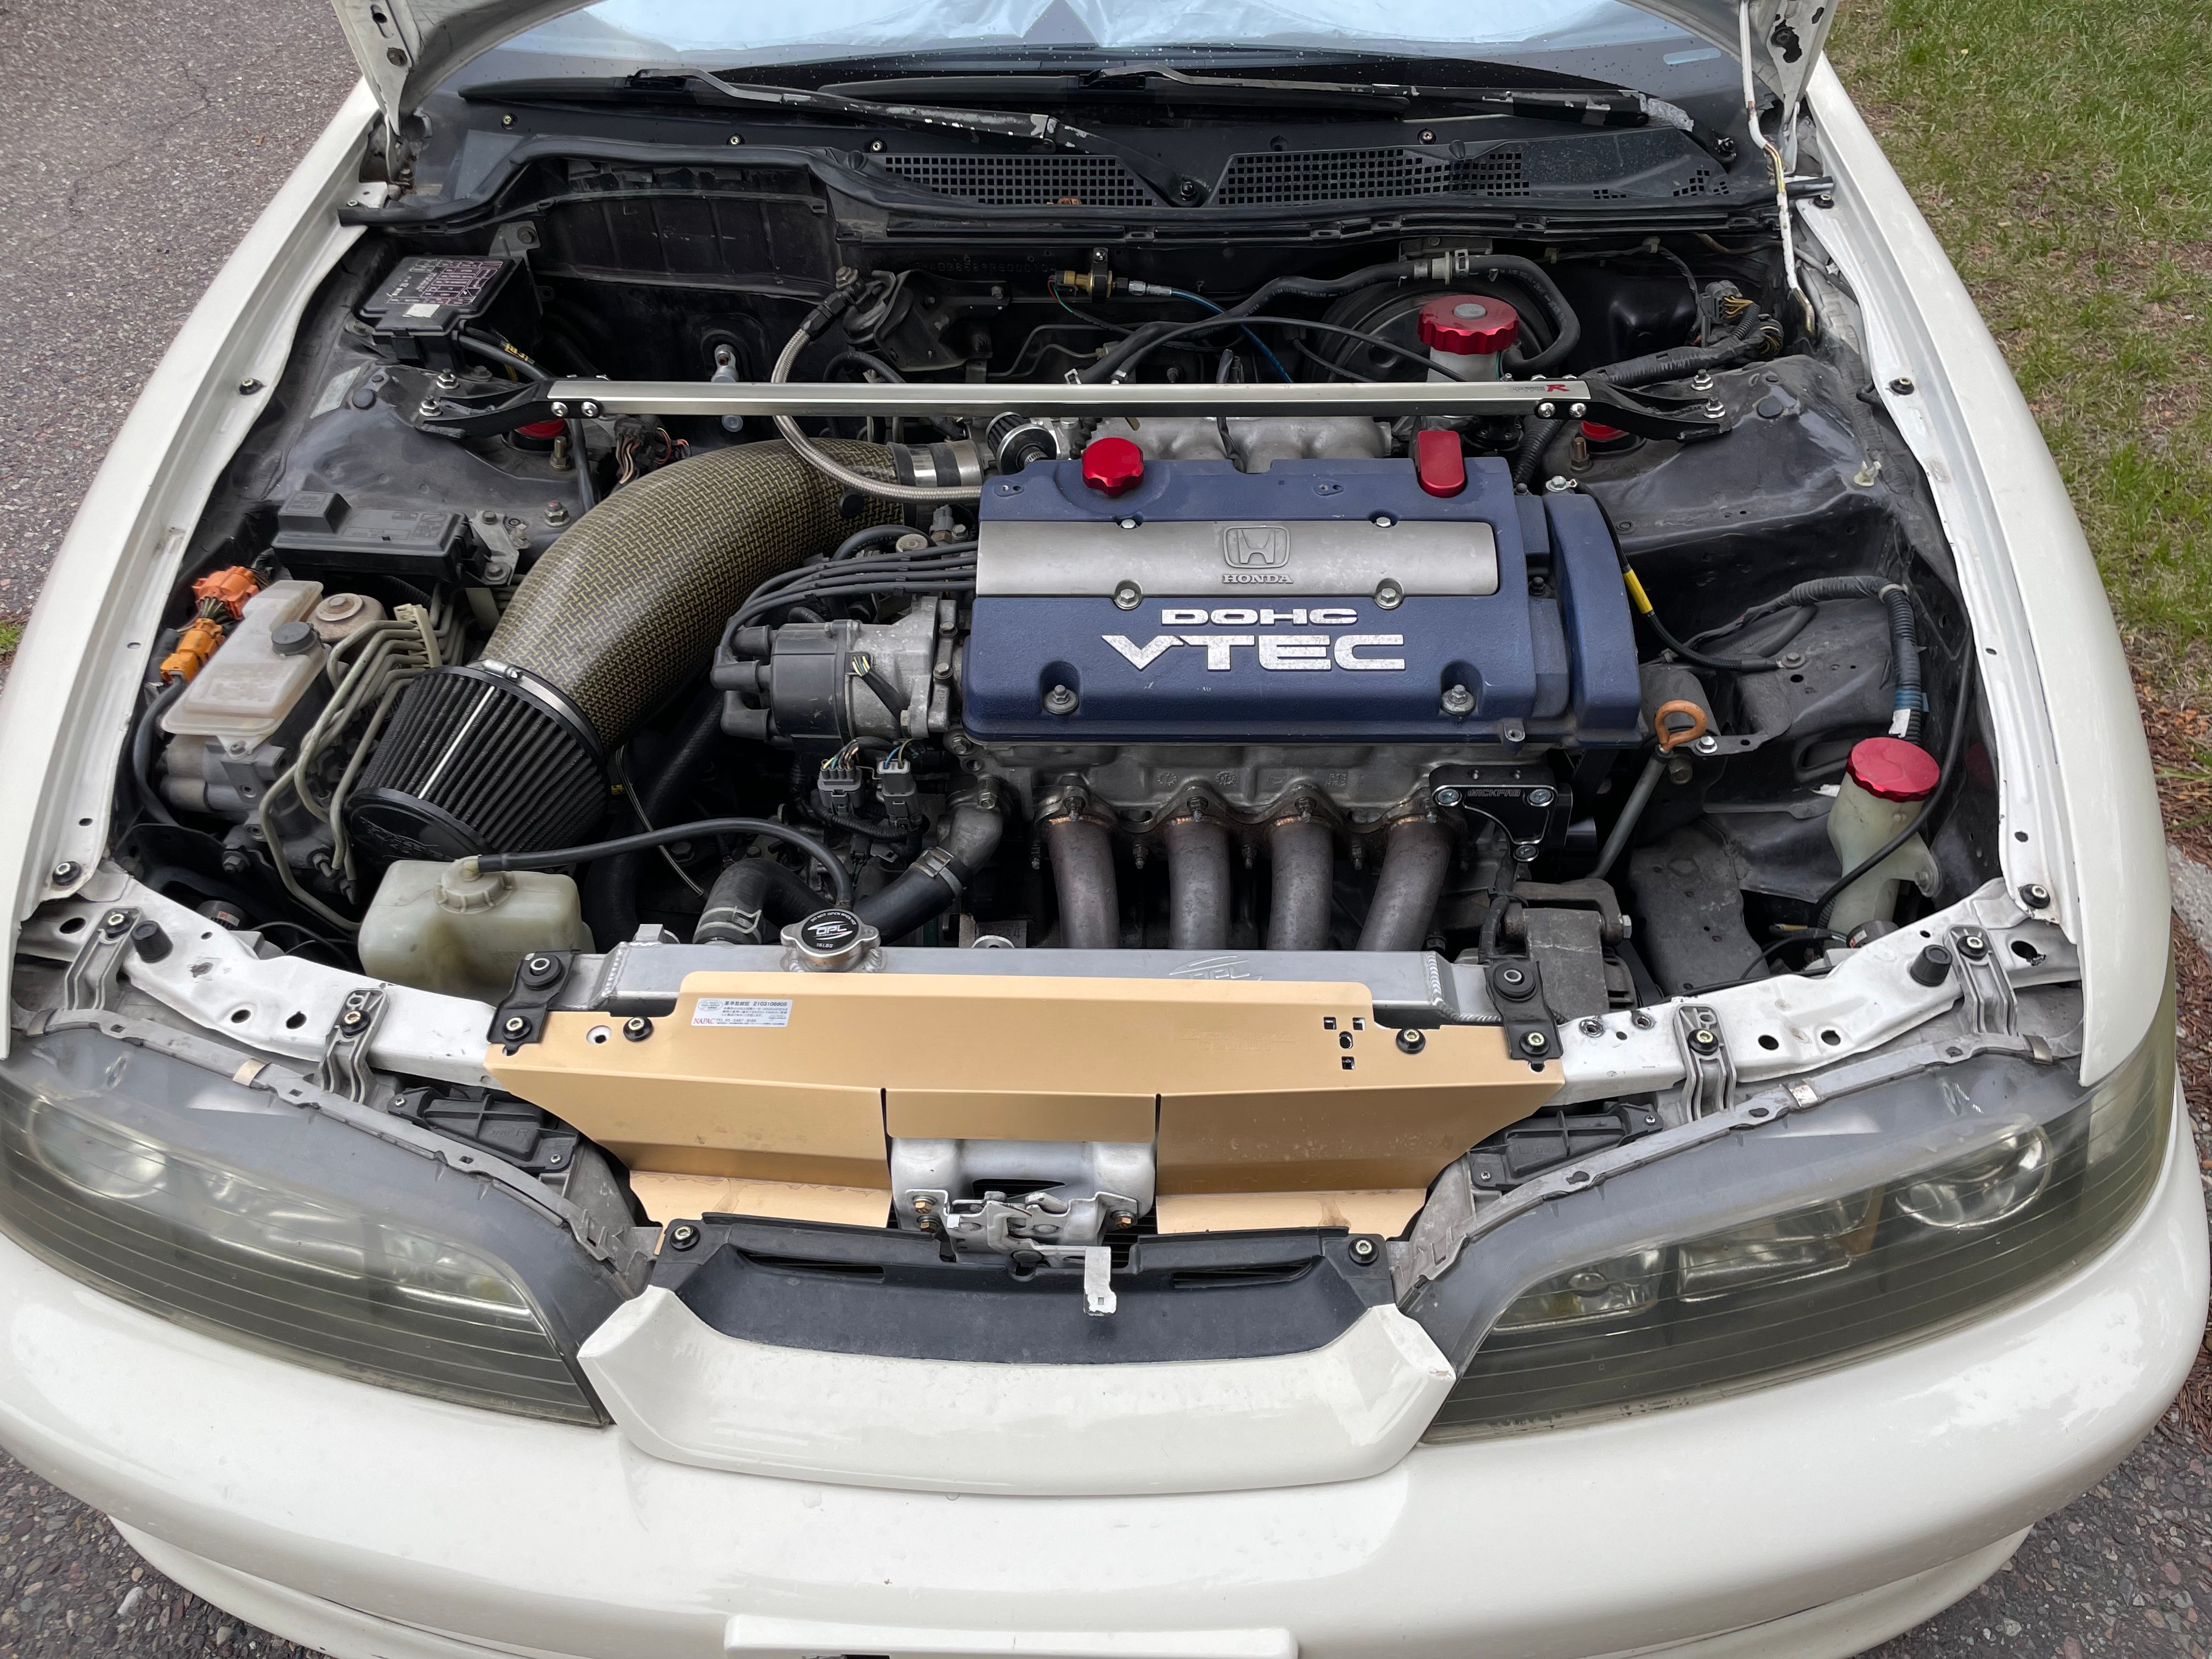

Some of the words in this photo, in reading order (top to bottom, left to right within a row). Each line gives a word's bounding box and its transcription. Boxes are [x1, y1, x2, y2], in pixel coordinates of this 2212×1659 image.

[1223, 574, 1294, 584] HONDA
[1161, 608, 1358, 627] DOHC
[1101, 634, 1406, 672] VTEC
